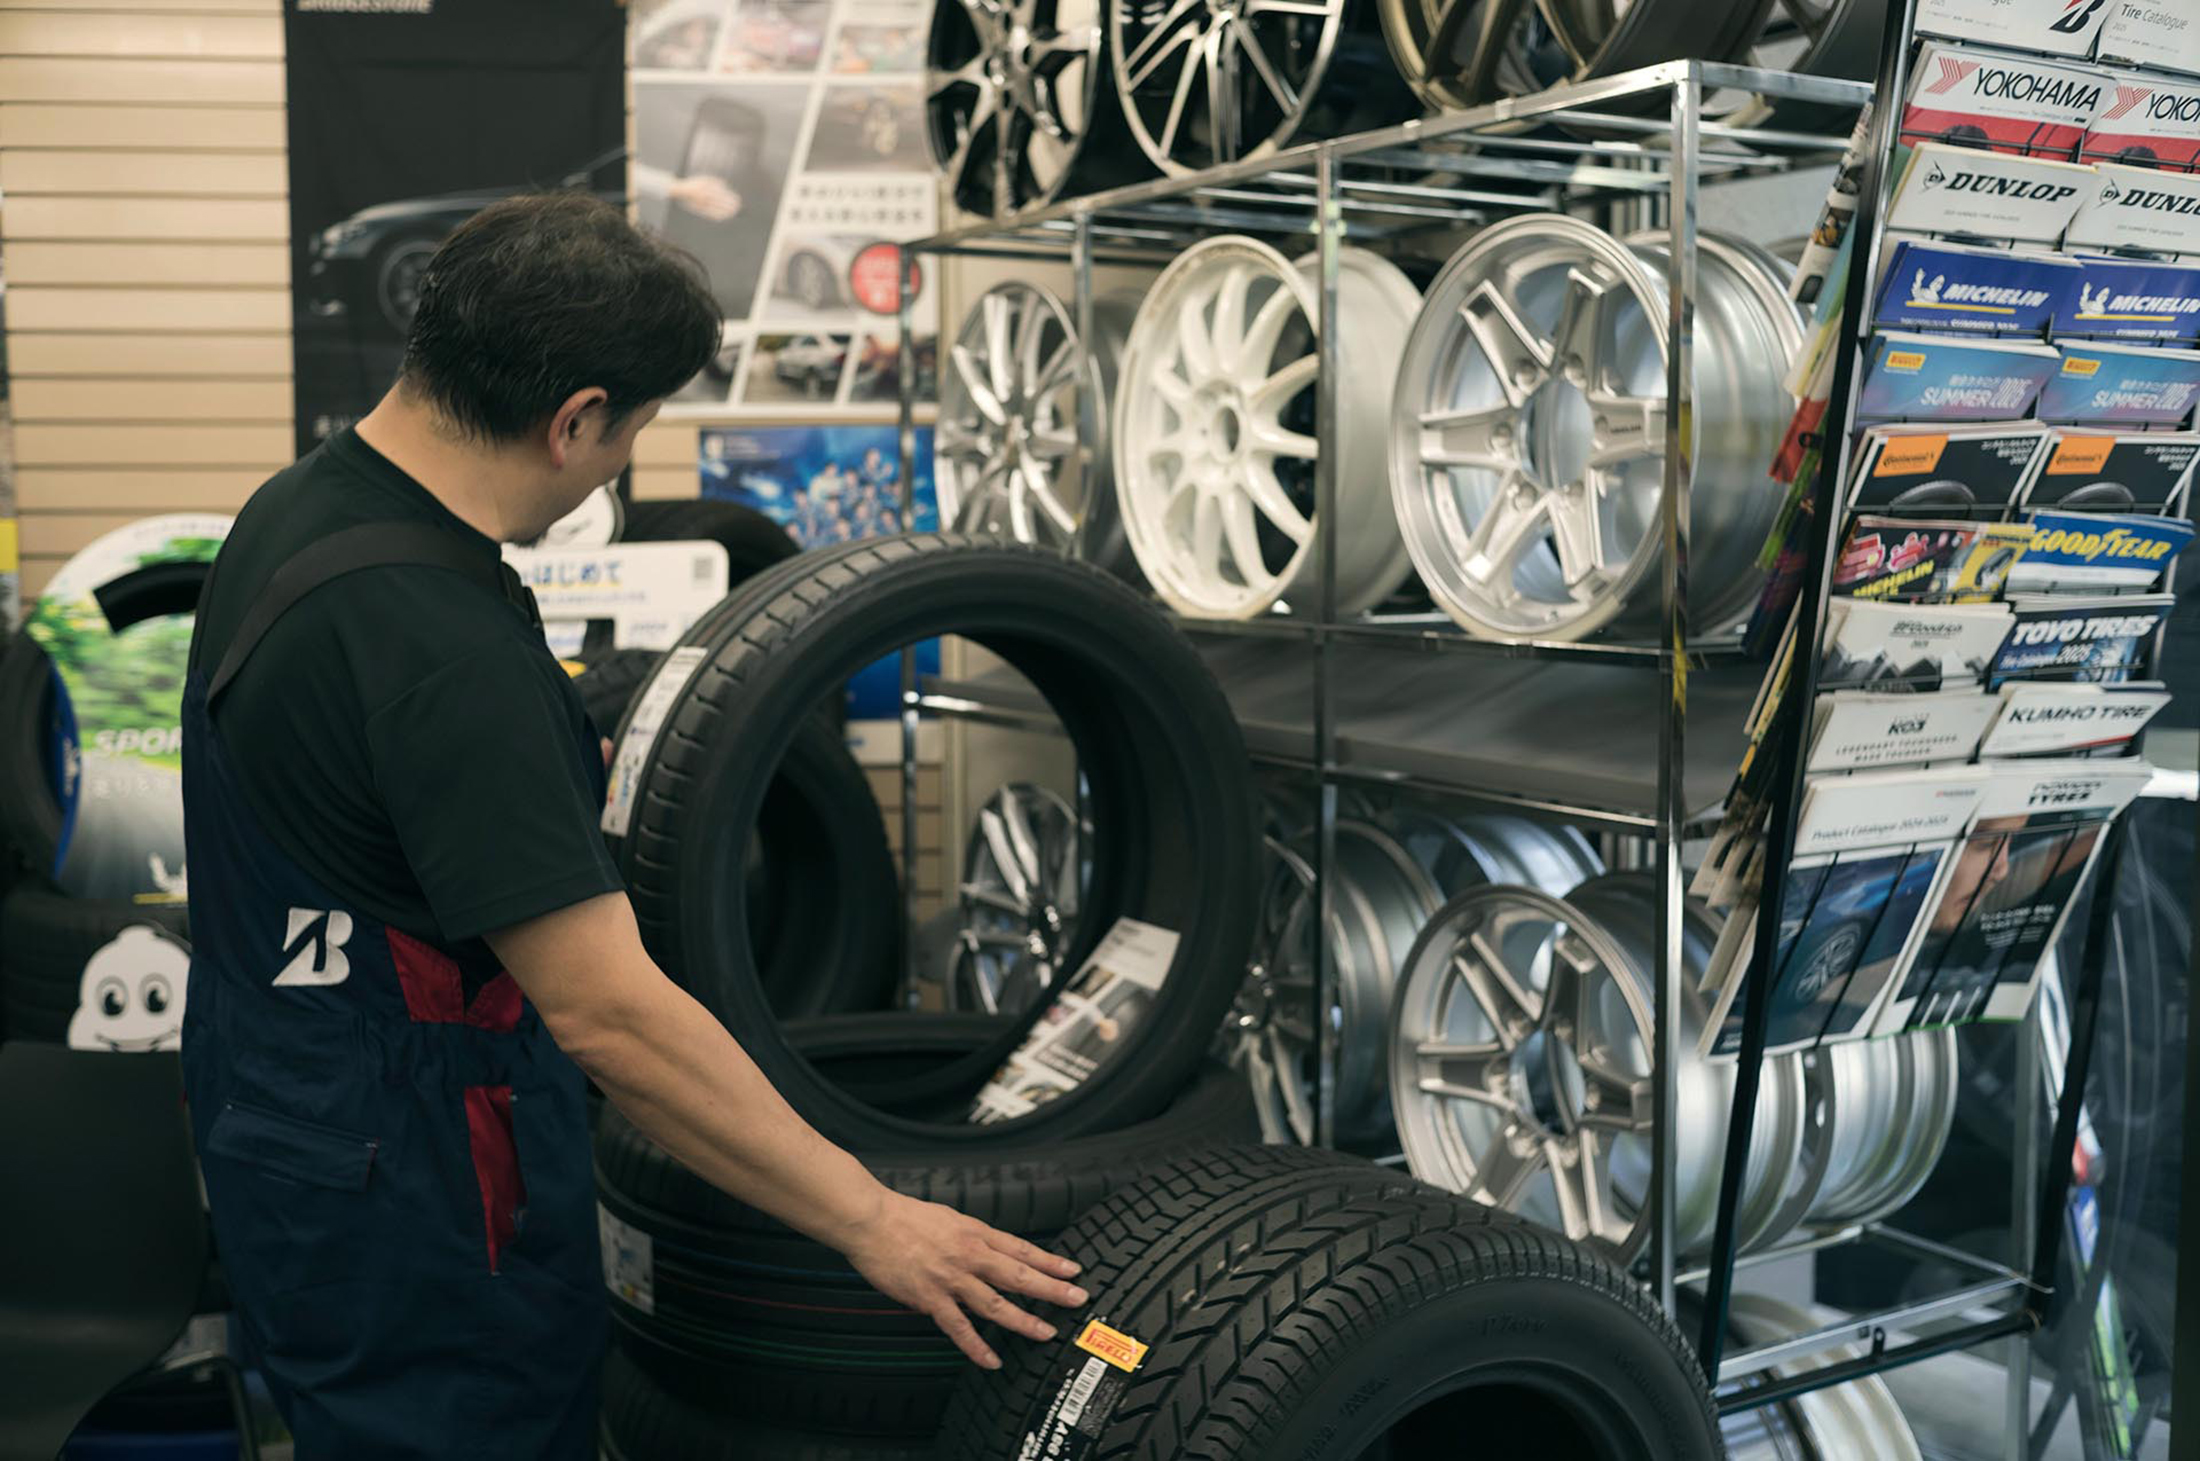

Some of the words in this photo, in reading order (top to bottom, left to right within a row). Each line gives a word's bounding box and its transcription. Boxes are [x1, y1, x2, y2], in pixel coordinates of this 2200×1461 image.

[2121, 3, 2142, 19] Tire
[2142, 9, 2188, 30] Catalogue
[1973, 67, 2102, 112] YOKOHAMA
[2145, 93, 2200, 122] YOKO
[1945, 172, 2077, 202] DUNLOP
[1942, 283, 2049, 308] MICHELIN
[1921, 387, 1992, 407] SUMMER
[2029, 528, 2172, 562] GOODYEAR
[2012, 618, 2084, 646] TOYO
[2081, 615, 2160, 640] TIRES
[2009, 705, 2096, 723] KUMHO
[2101, 704, 2152, 719] TIRE
